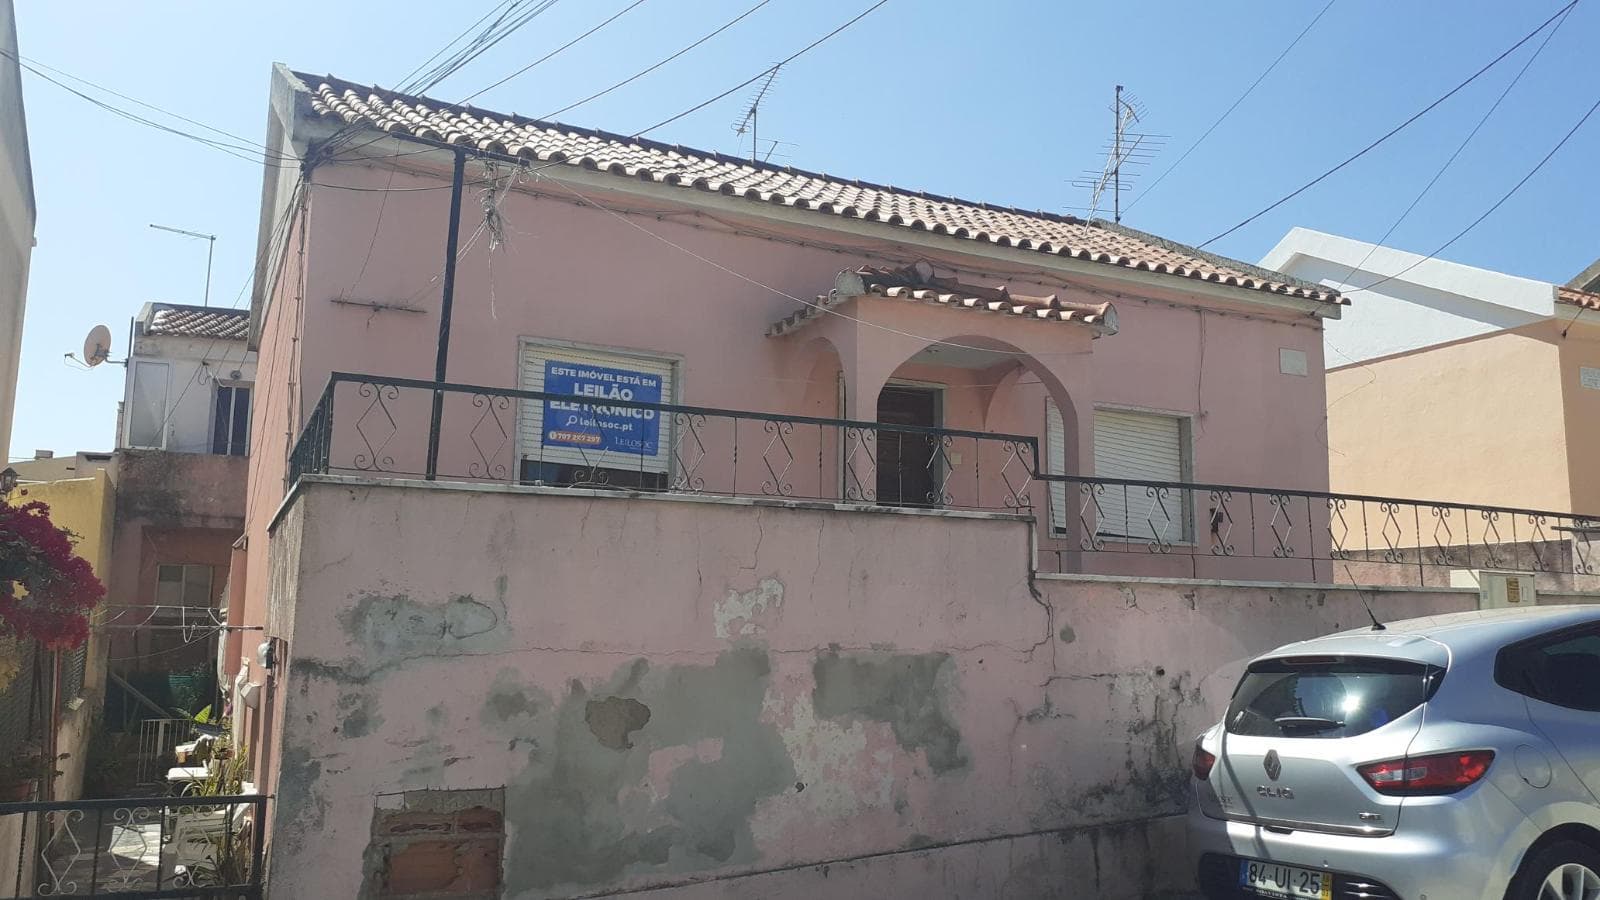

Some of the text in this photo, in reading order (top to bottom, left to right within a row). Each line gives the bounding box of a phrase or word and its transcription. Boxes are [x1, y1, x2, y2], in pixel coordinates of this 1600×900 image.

[551, 366, 657, 388] ESTE IMÓVEL ESTÁ EM
[574, 382, 634, 401] LEILÃO
[1256, 785, 1295, 800] CLIO
